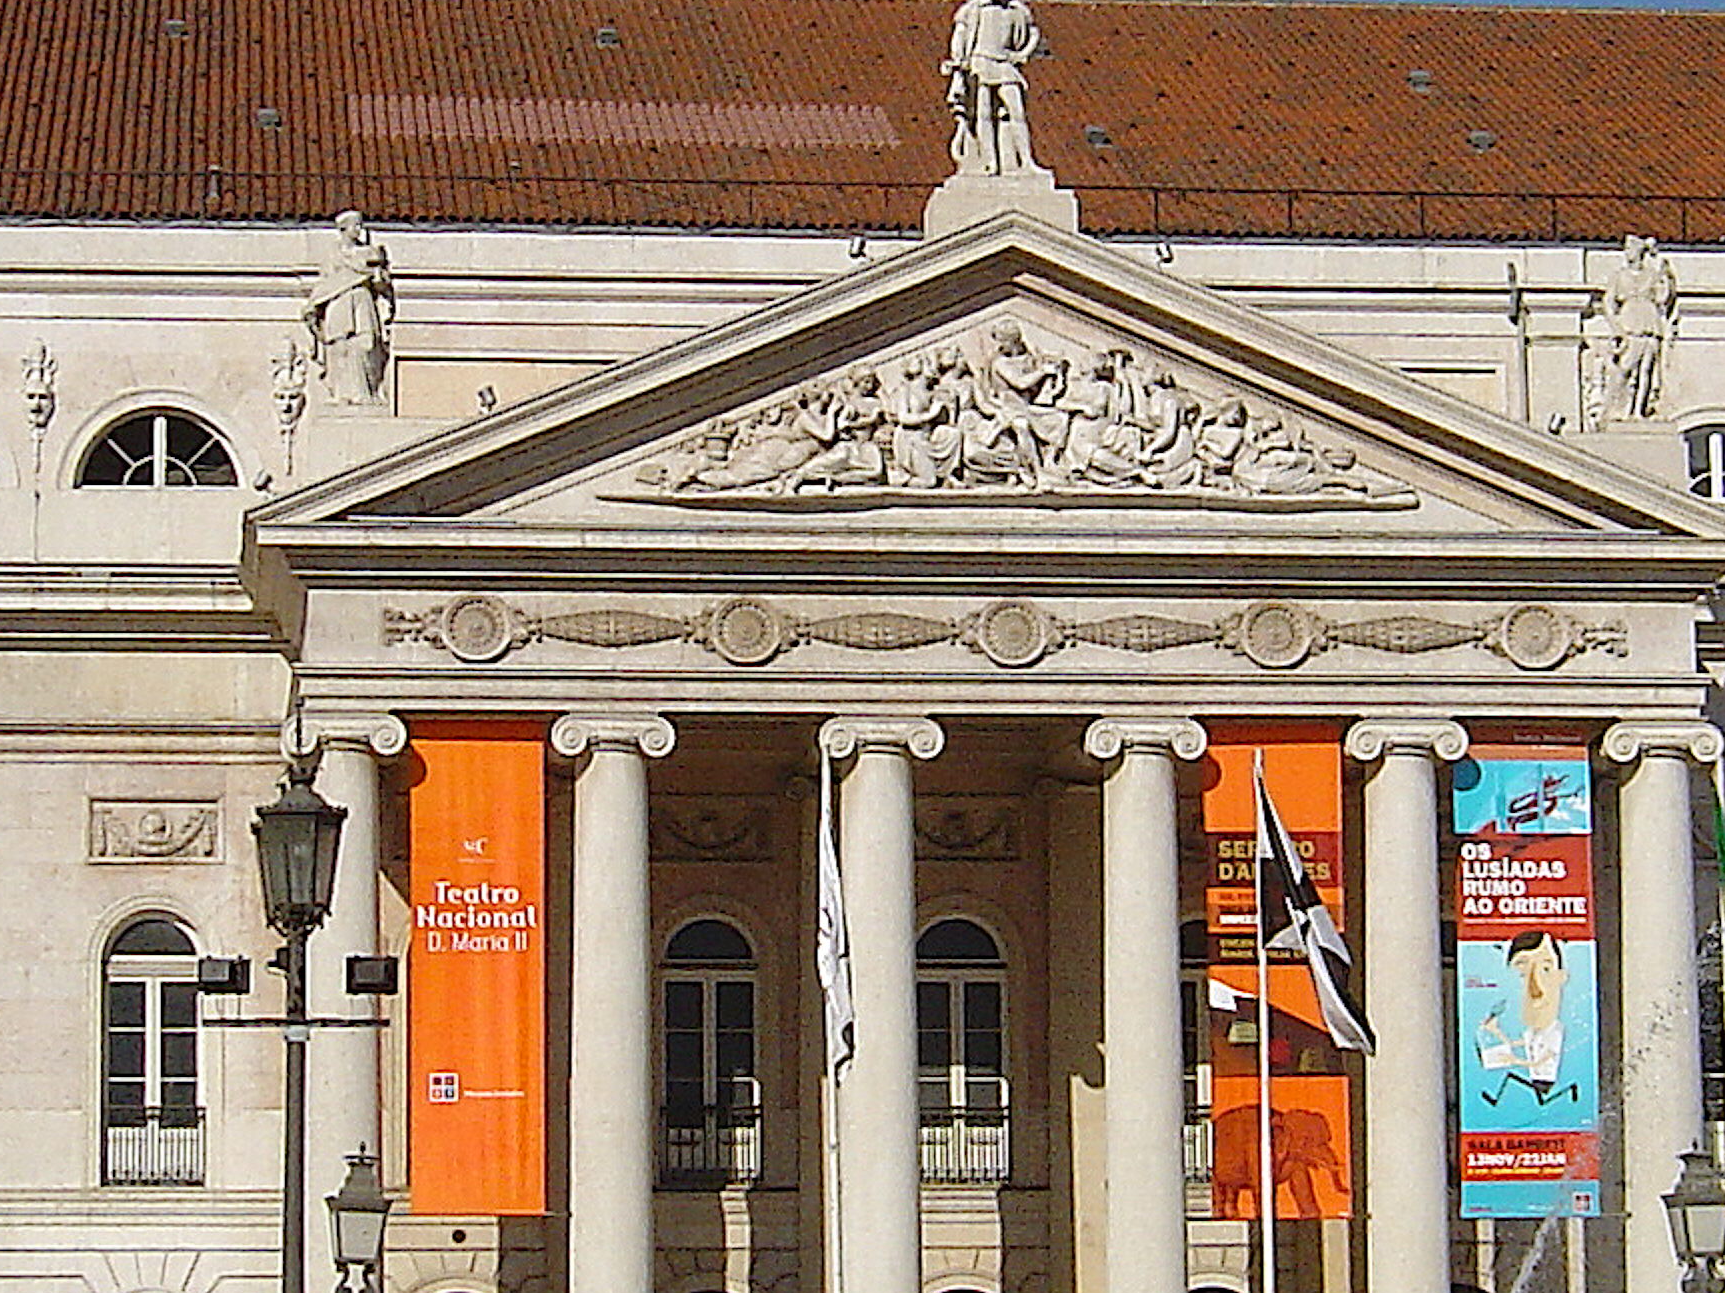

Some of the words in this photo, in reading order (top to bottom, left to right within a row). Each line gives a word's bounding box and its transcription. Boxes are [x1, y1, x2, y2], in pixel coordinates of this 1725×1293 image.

[1461, 842, 1492, 860] OS
[435, 881, 519, 904] Teatro
[1463, 879, 1526, 896] RUMO
[1463, 897, 1494, 914] AO
[1499, 897, 1587, 914] ORIENTE
[416, 904, 537, 928] Nacional
[427, 930, 447, 952] D.
[452, 931, 509, 952] Maria
[515, 930, 528, 951] II
